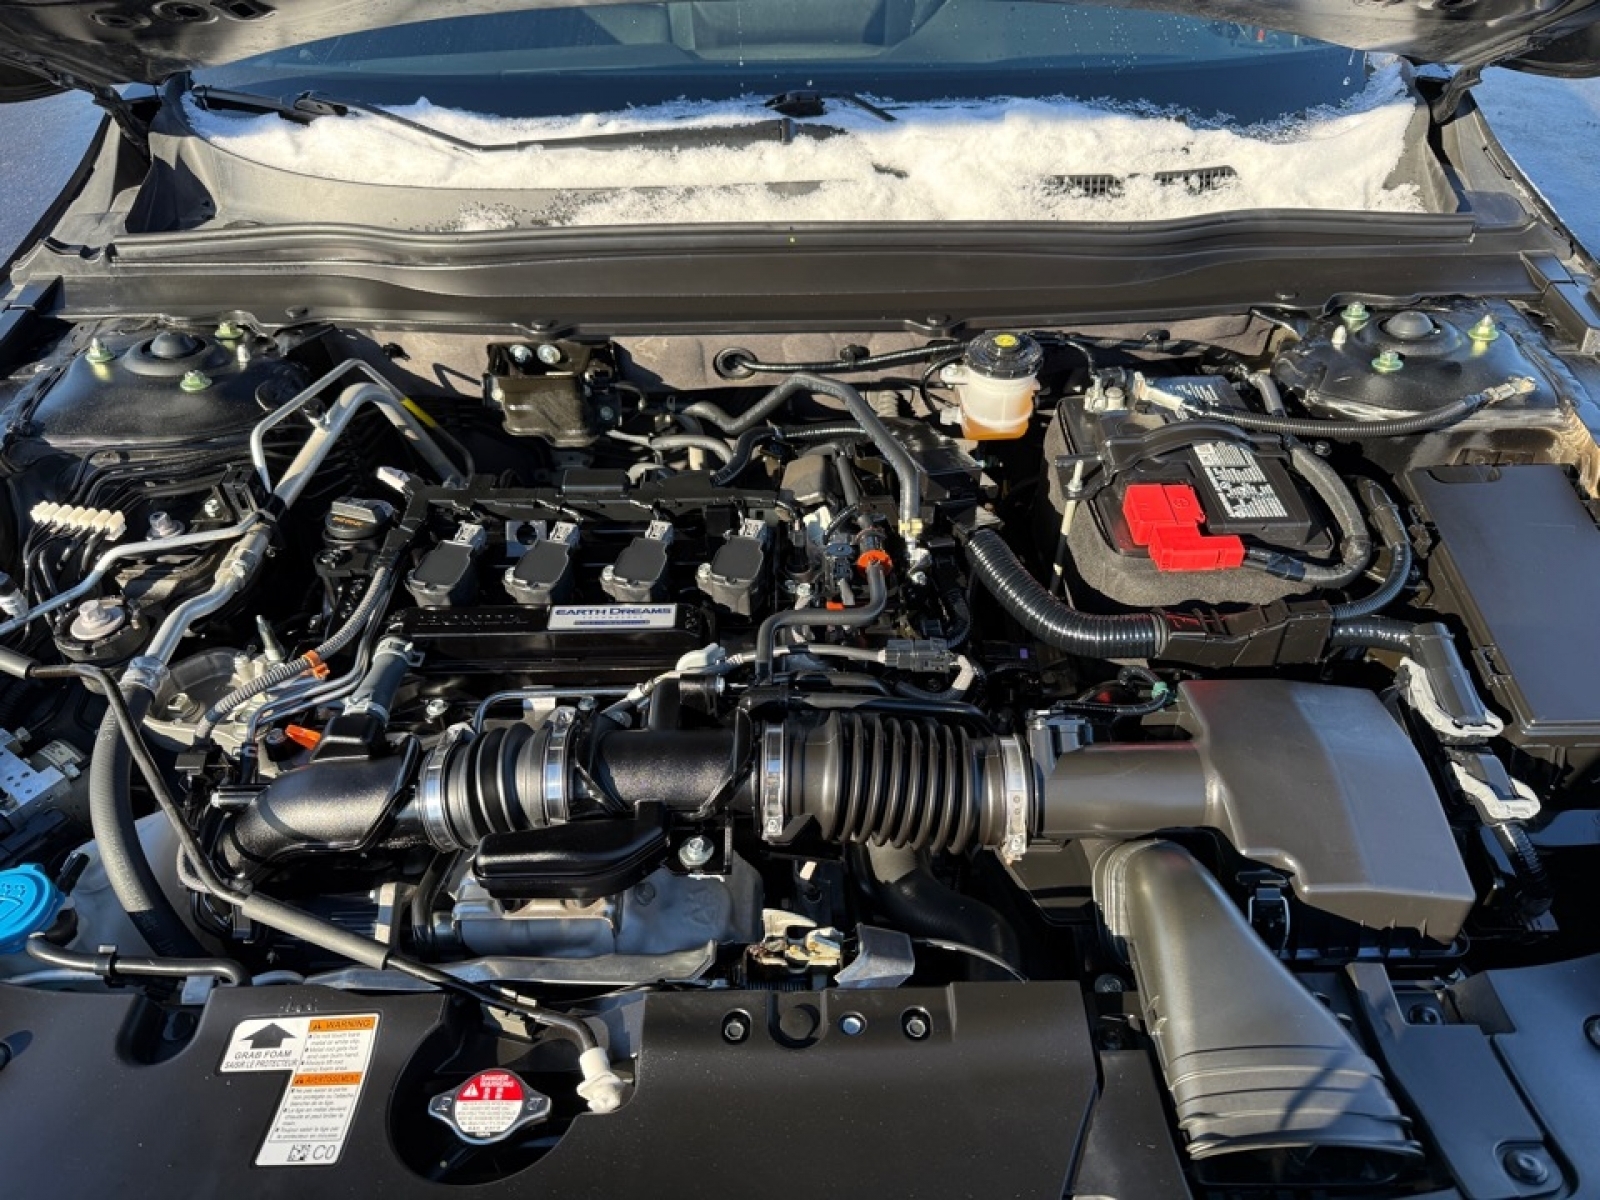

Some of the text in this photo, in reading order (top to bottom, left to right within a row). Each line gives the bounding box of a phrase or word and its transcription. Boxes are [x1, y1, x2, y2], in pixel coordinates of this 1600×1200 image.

[326, 1020, 370, 1028] WARNING
[262, 1050, 292, 1058] FOAM
[306, 1074, 360, 1083] AVERTISSEMENT
